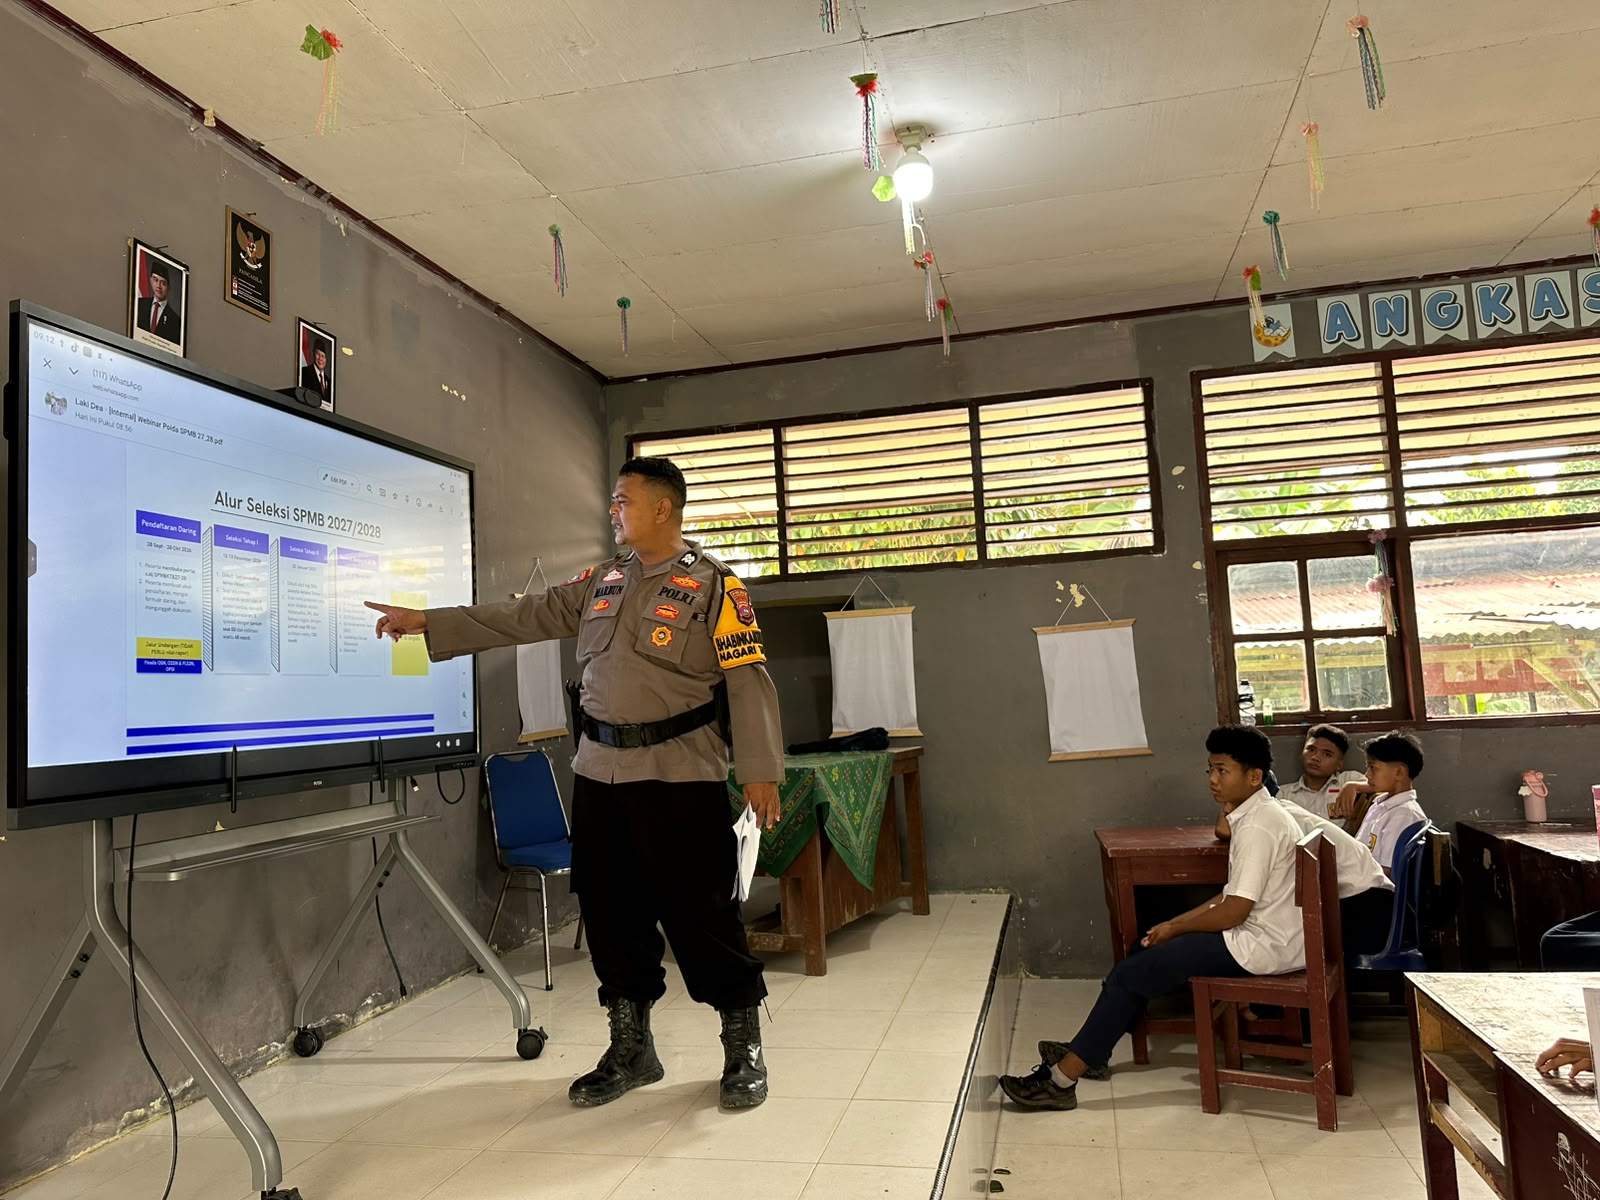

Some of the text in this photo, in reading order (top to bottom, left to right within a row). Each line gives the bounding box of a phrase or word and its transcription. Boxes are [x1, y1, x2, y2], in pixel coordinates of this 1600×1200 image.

[92, 368, 142, 392] (117) WhatsApp
[75, 398, 90, 409] Laki
[90, 402, 104, 412] Dea
[108, 406, 136, 423] [Internal]
[137, 415, 162, 428] Webinar
[162, 422, 178, 434] Polda
[180, 427, 196, 438] SPMB
[75, 412, 88, 420] Hari
[98, 417, 114, 428] Pukul
[214, 490, 382, 538] Alur Seleksi SPMB 2027/2028
[141, 519, 197, 536] Pendaftaran Daring
[226, 534, 242, 543] Seleksi
[243, 537, 256, 546] Tahap
[658, 586, 697, 606] POLRI
[719, 644, 757, 662] NAGARI
